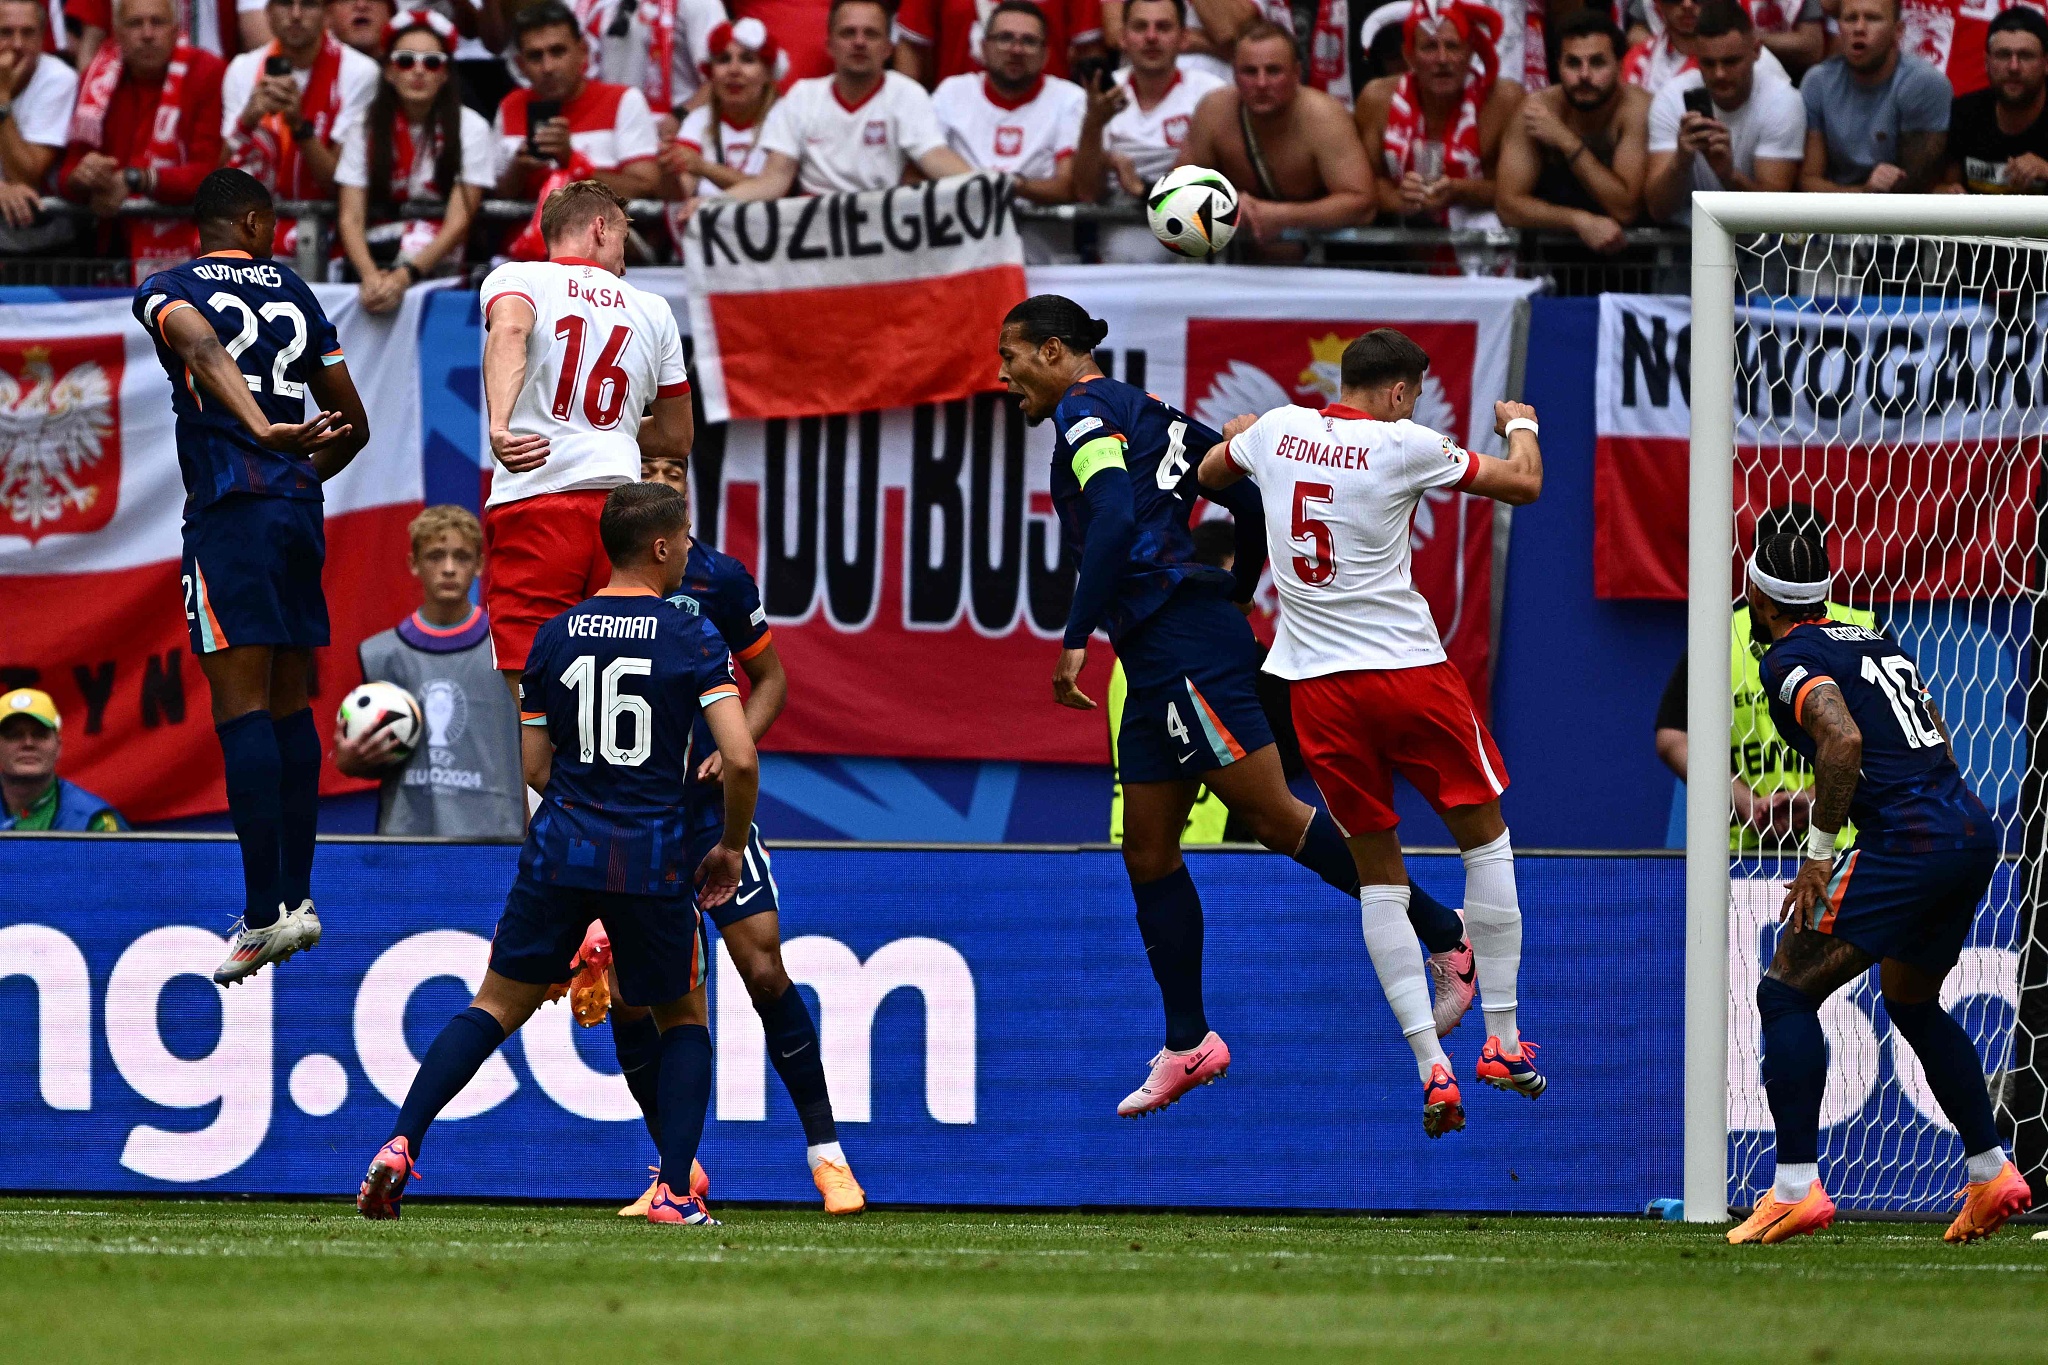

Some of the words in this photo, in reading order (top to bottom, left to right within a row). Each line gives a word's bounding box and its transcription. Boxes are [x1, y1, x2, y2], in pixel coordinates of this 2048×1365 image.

[207, 291, 304, 399] 22
[552, 314, 633, 431] 16
[1276, 434, 1370, 470] BEDNAREK
[1291, 480, 1337, 588] 5
[567, 614, 658, 640] VEERMAN
[559, 655, 652, 767] 16
[1166, 701, 1190, 745] 4
[1860, 654, 1946, 749] 10
